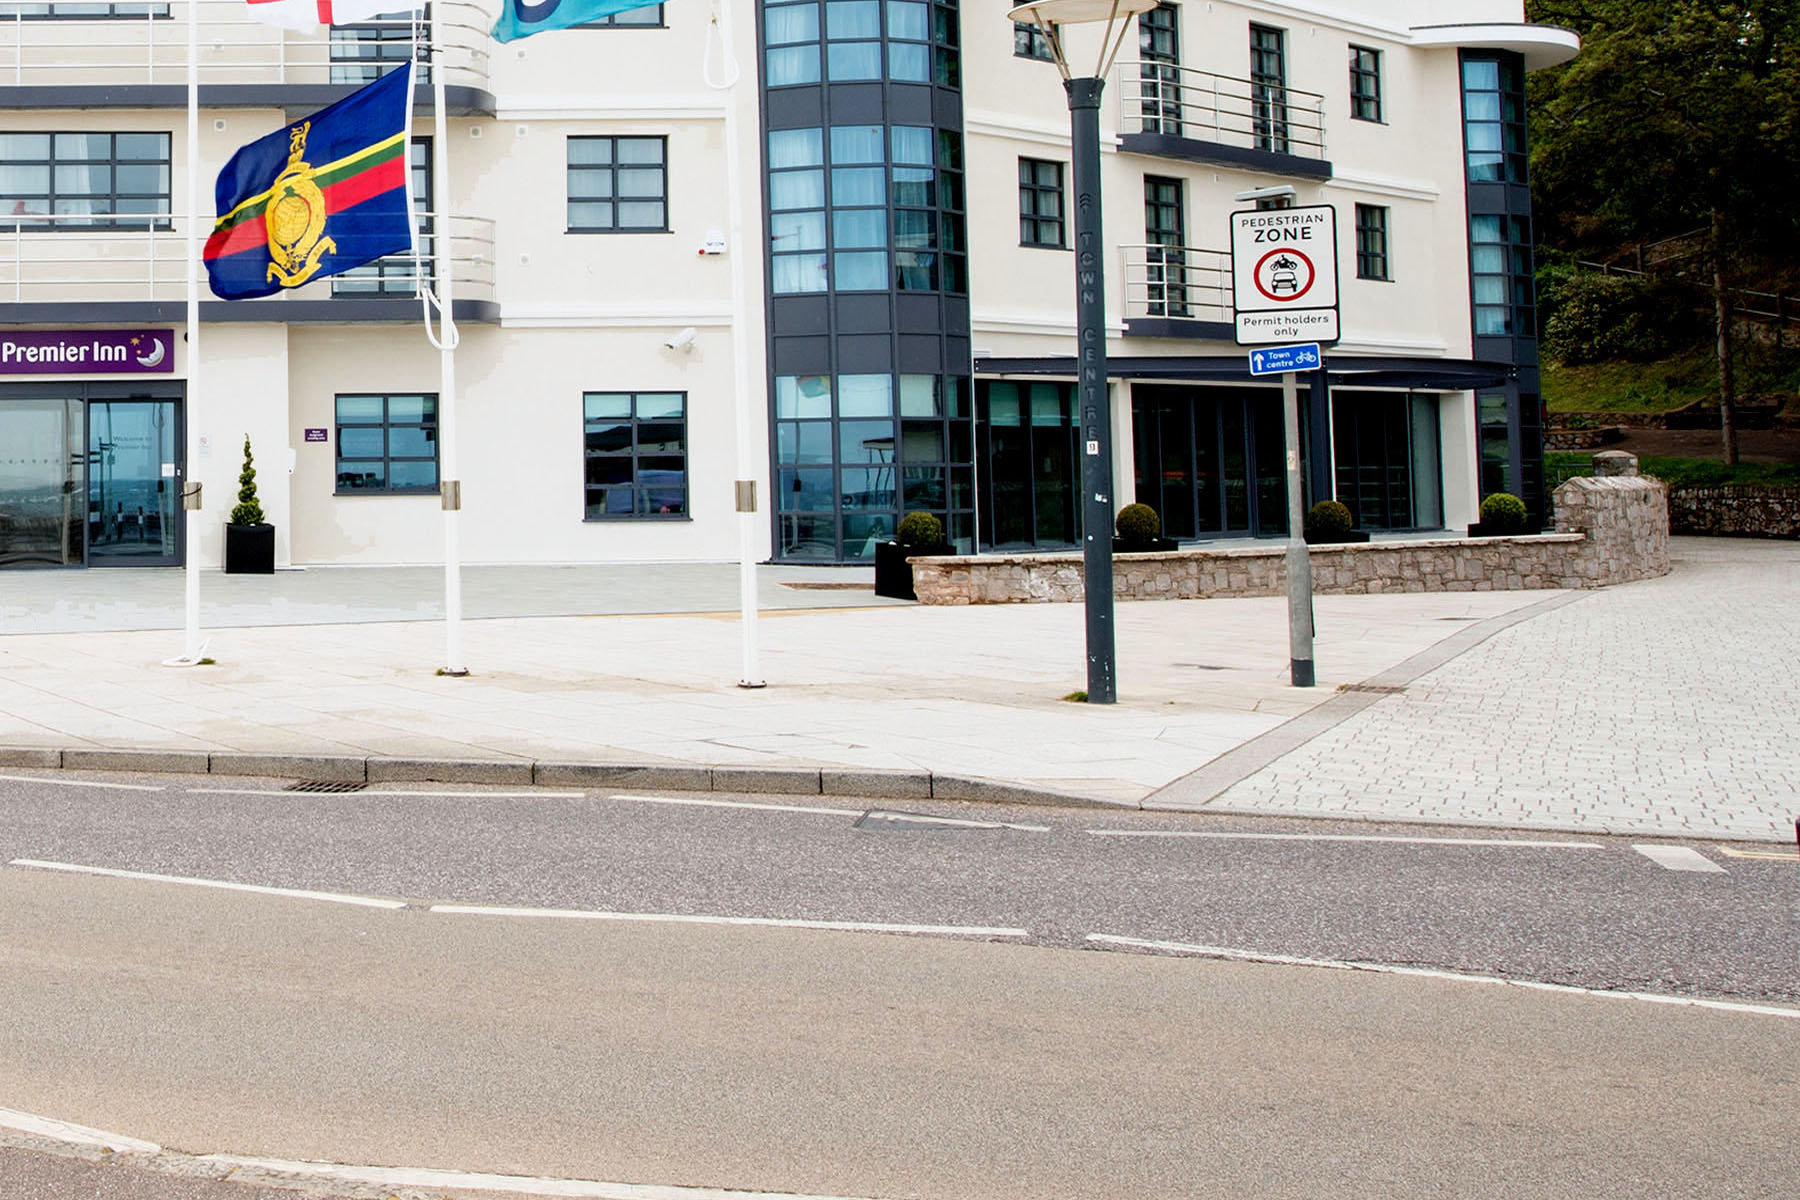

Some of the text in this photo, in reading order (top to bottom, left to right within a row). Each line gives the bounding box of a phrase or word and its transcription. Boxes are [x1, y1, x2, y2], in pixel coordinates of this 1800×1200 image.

[1242, 214, 1323, 227] PEDESTRIAN
[1254, 227, 1313, 243] ZONE
[1243, 314, 1329, 326] Permit holders
[1079, 232, 1098, 440] TOWN CENTRE
[1274, 327, 1299, 336] only
[2, 341, 127, 362] Premier Inn
[1269, 351, 1291, 360] Town
[1266, 359, 1294, 368] centre
